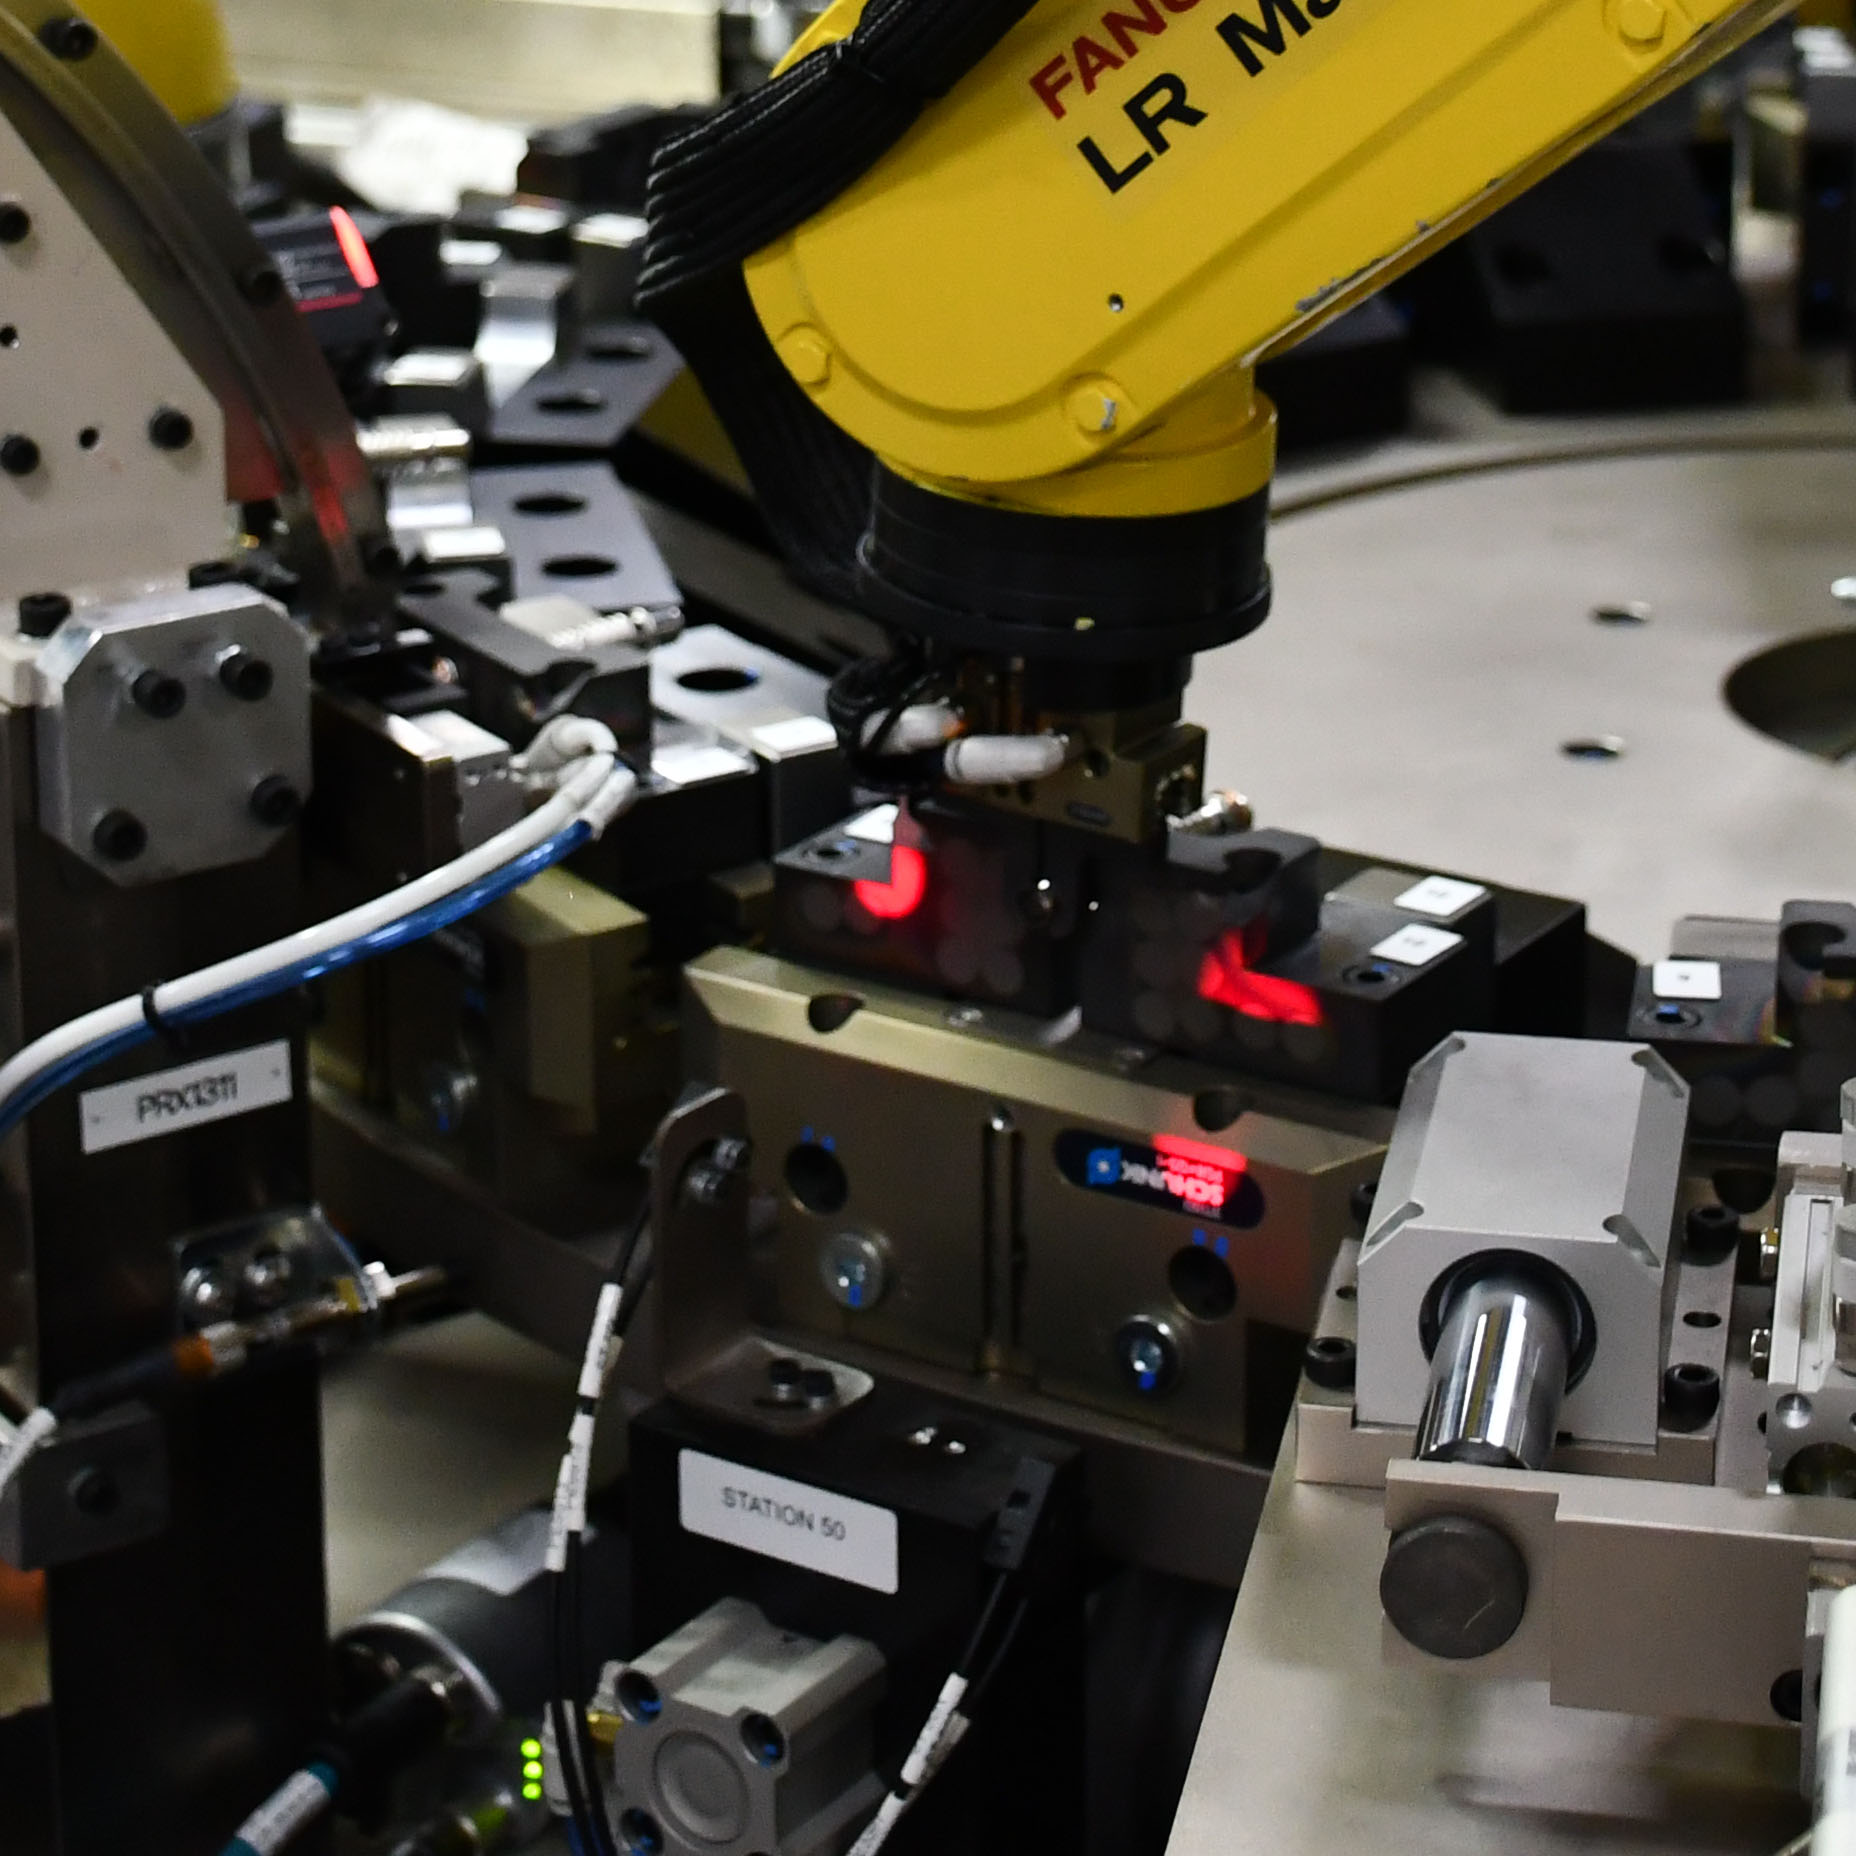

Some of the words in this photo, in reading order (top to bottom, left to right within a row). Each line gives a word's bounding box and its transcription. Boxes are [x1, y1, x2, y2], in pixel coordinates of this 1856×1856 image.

[1077, 72, 1209, 195] LR
[721, 1485, 815, 1532] STATION
[820, 1515, 847, 1541] 50
